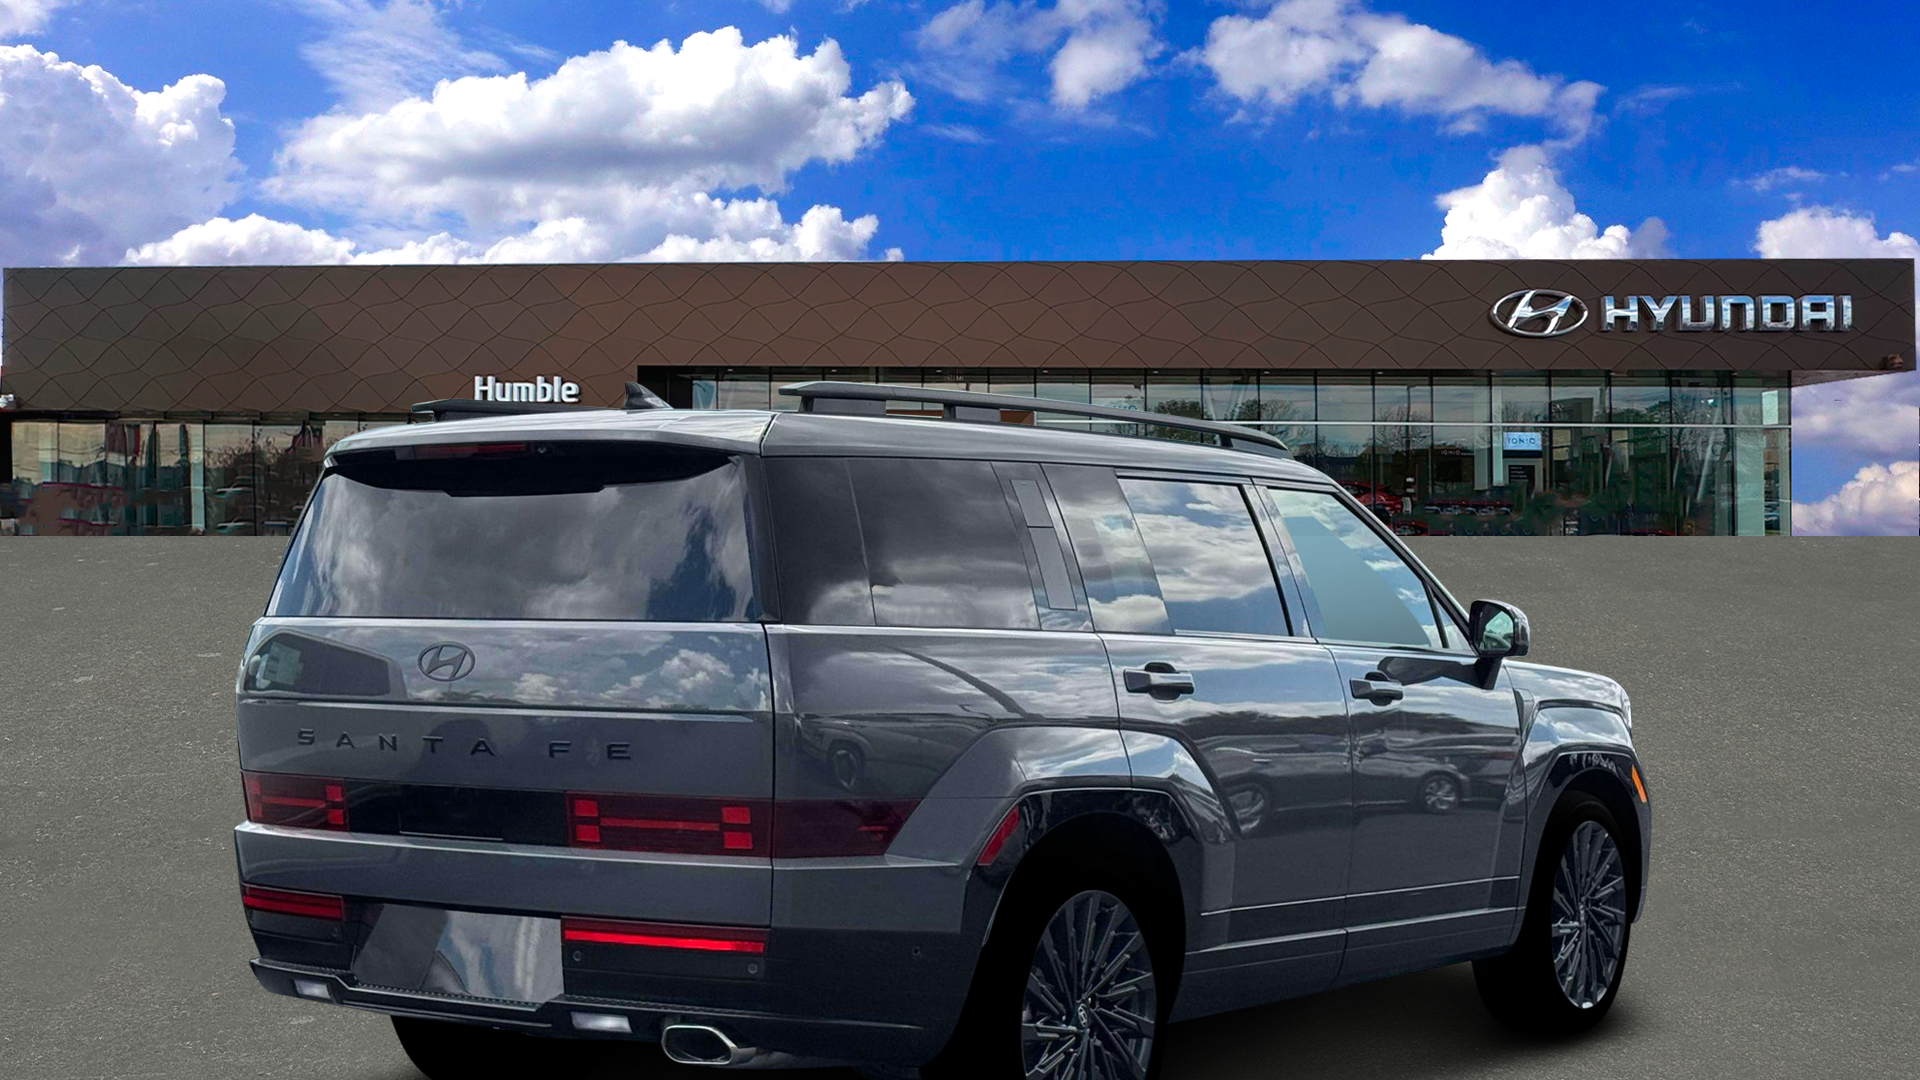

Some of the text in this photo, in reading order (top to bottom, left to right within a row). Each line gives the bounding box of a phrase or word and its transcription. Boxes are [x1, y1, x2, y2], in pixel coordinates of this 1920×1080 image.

[1602, 295, 1852, 332] HYUNDAI
[474, 375, 580, 403] Humble
[297, 728, 631, 761] SANTA FE
